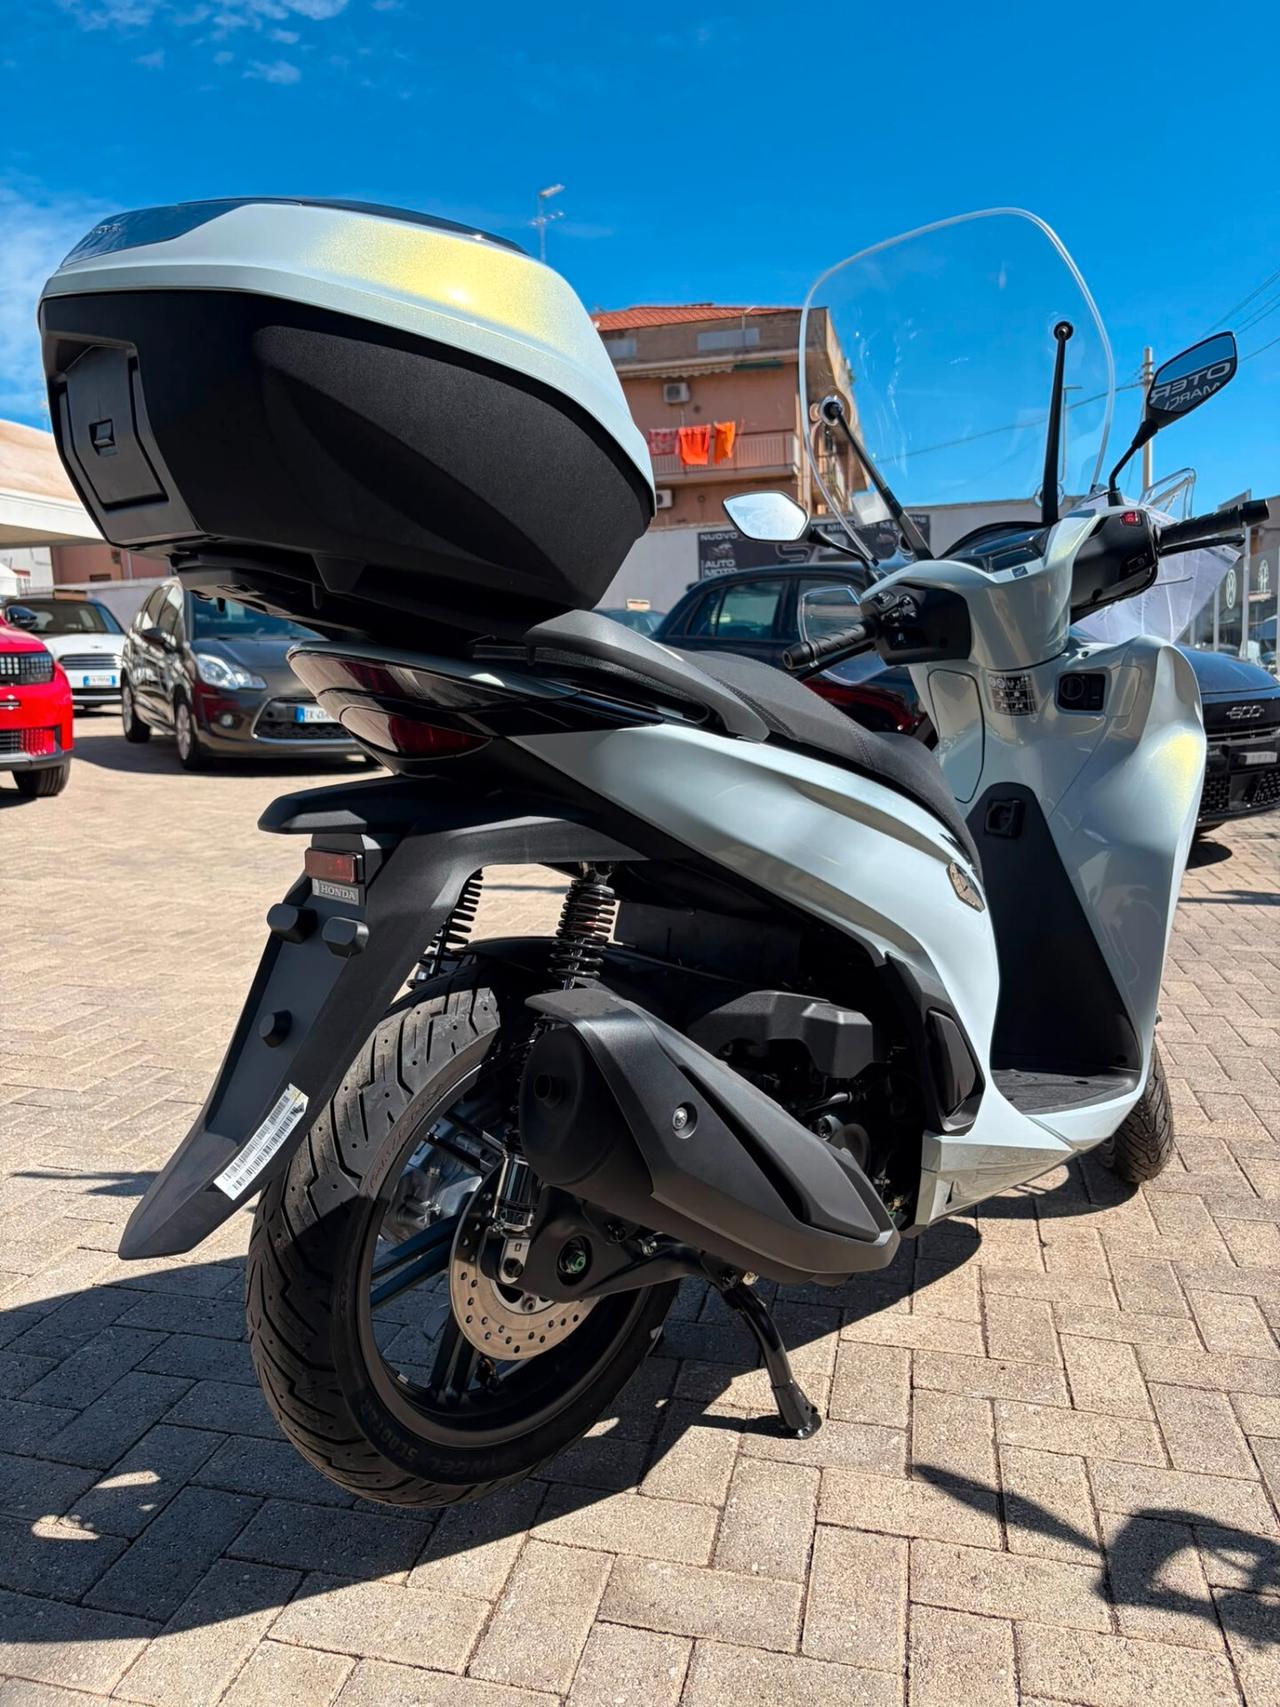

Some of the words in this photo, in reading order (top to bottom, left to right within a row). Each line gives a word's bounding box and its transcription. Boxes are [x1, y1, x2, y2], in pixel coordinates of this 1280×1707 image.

[700, 532, 738, 541] NUOVO
[705, 559, 736, 568] AUTO
[321, 884, 357, 900] HONDA
